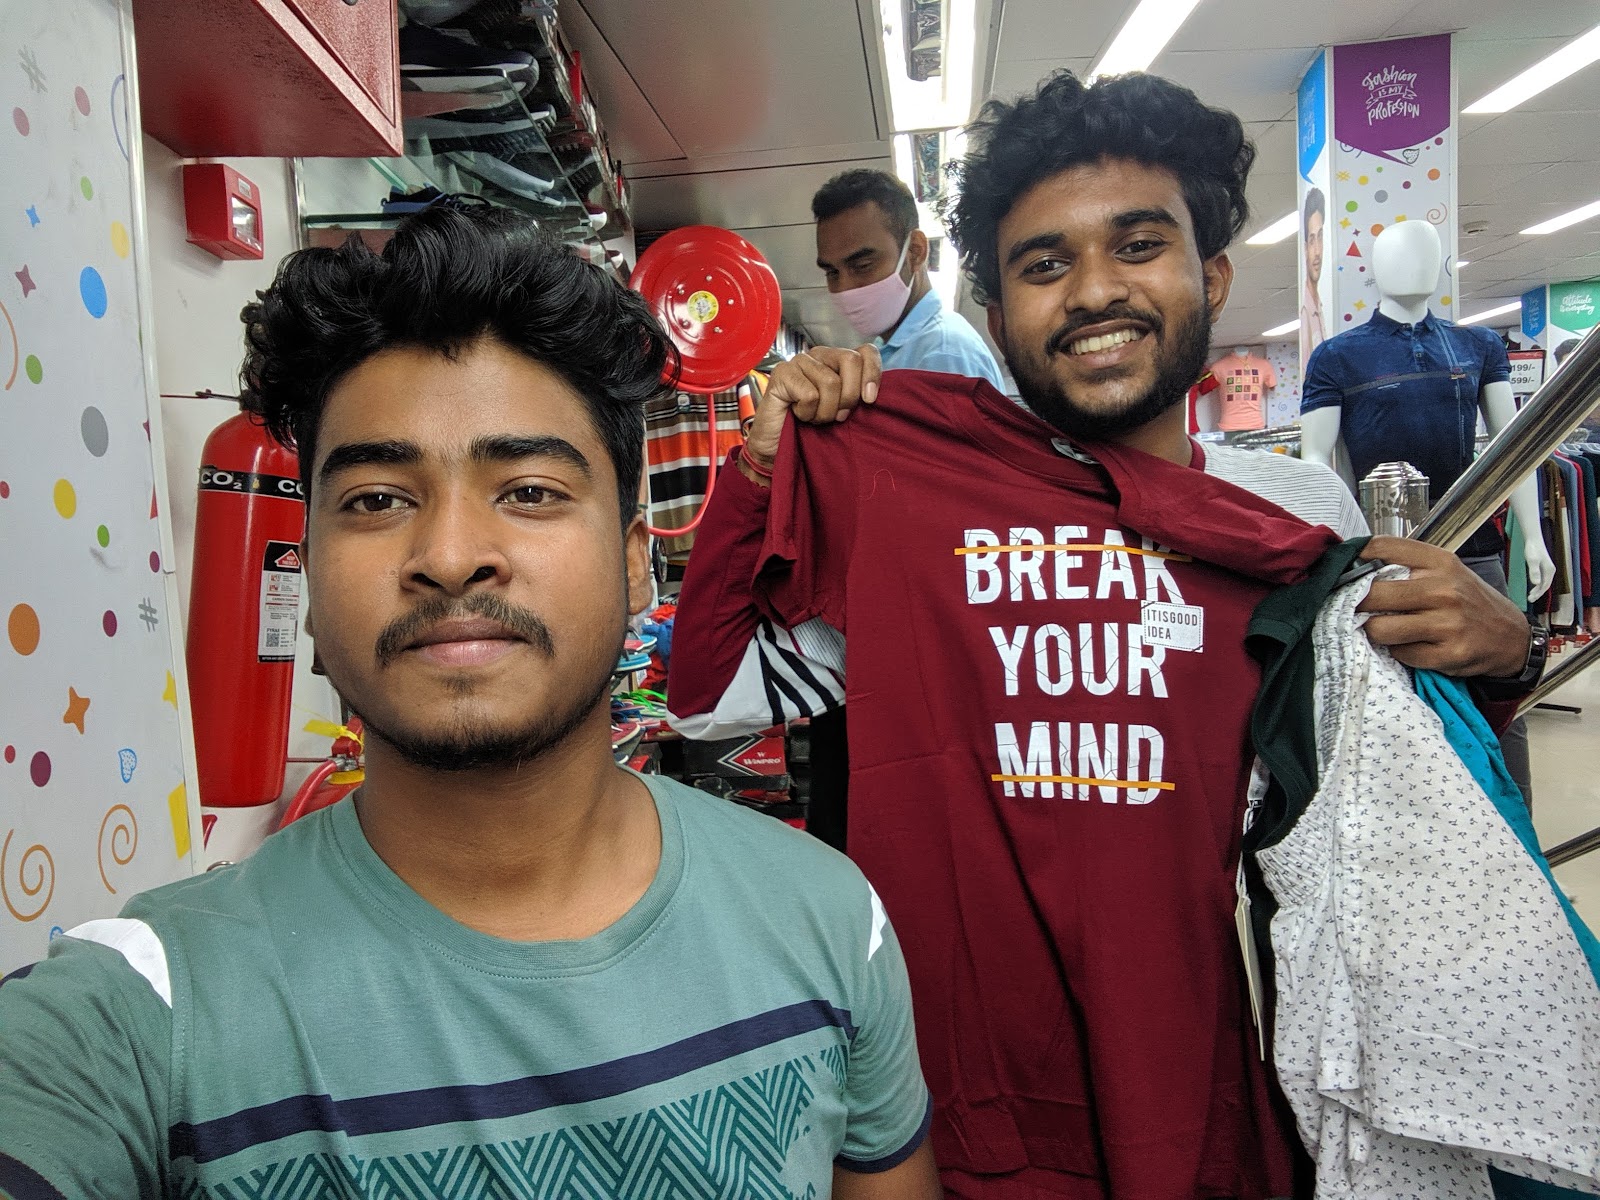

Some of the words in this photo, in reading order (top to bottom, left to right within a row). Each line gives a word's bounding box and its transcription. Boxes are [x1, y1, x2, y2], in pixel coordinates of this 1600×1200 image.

[1389, 86, 1403, 94] MY
[963, 525, 1185, 605] BREAK
[1147, 608, 1198, 626] ITISGOOD
[1147, 626, 1172, 640] IDEA
[988, 622, 1169, 698] YOUR
[743, 757, 781, 765] WINPRO
[994, 721, 1164, 805] MIND
